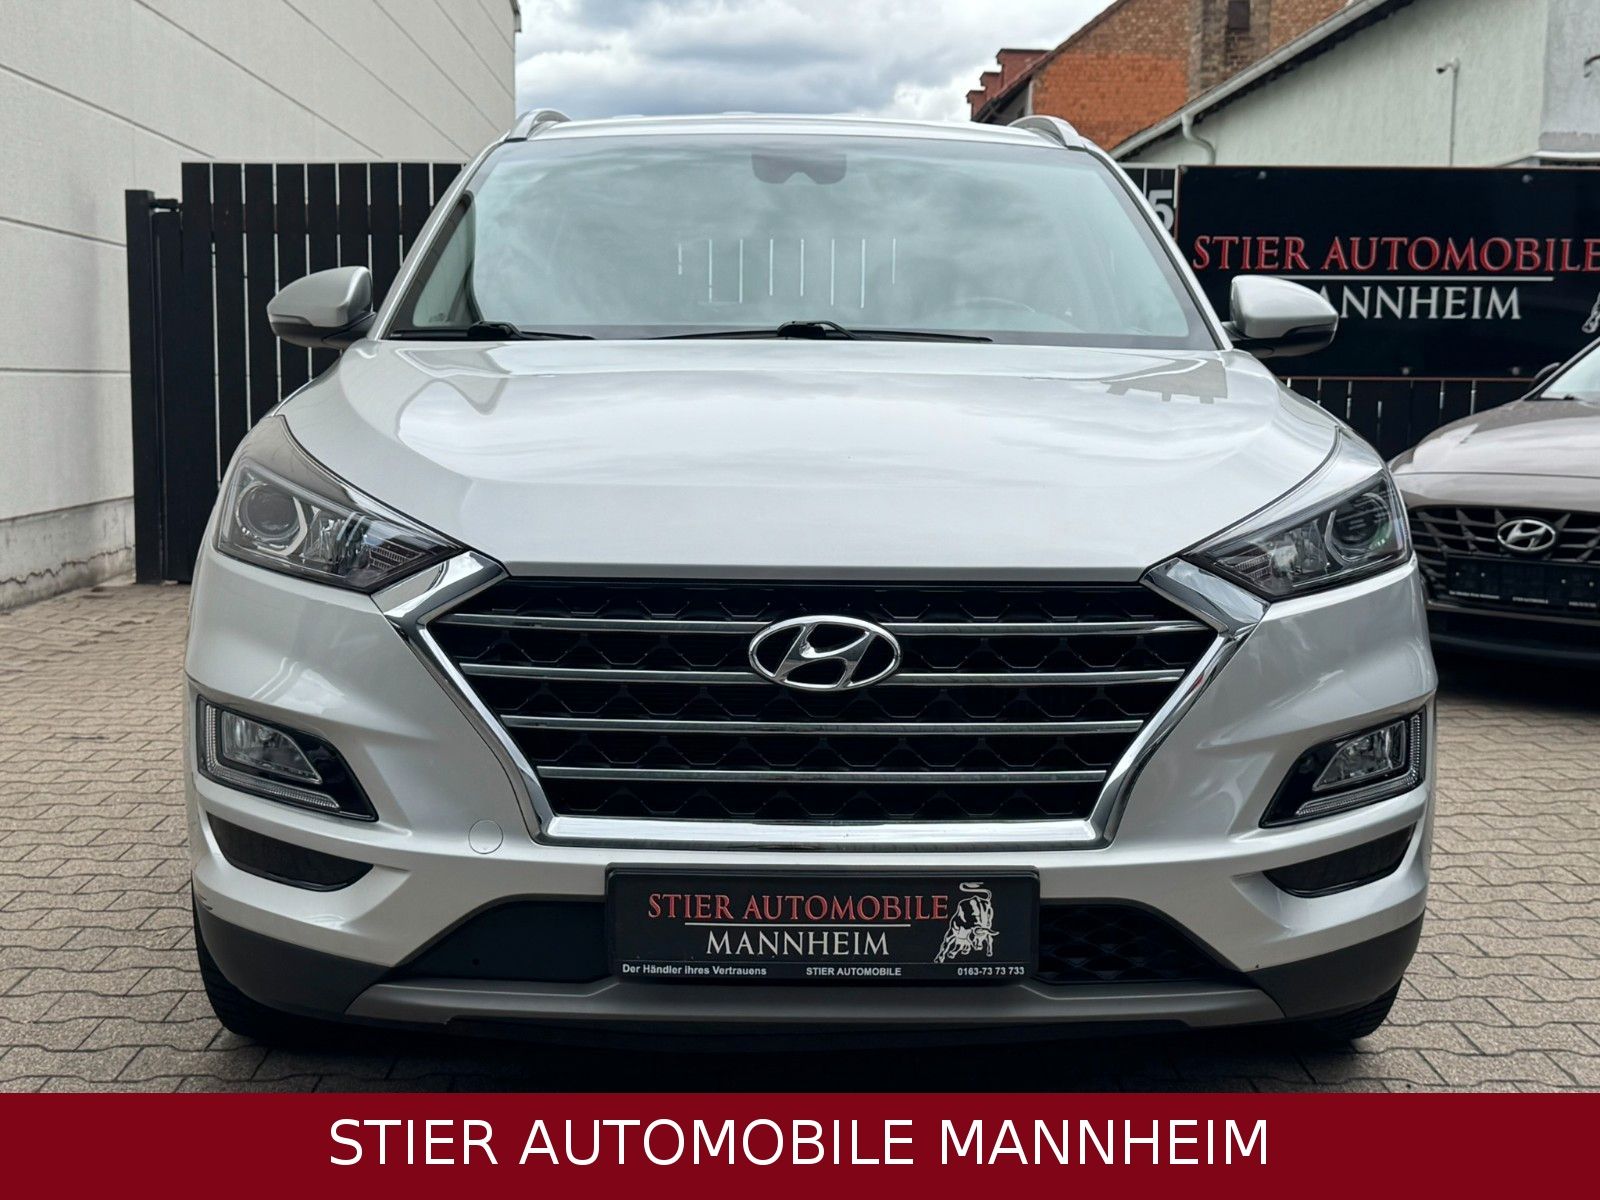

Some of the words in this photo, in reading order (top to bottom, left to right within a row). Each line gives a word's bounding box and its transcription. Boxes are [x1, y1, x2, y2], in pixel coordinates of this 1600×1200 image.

[1192, 235, 1310, 271] STIER
[1320, 236, 1600, 272] AUTOMOBILE
[1319, 285, 1521, 320] NNHEIM
[648, 893, 734, 920] STIER
[742, 894, 949, 921] AUTOMOBILE
[706, 930, 889, 956] MANNHEIM
[622, 963, 641, 974] Der
[642, 964, 683, 975] Händler
[712, 965, 767, 976] Vertrauens
[806, 966, 835, 977] STIER
[836, 967, 902, 977] AUTOMOBILE
[957, 966, 993, 977] 0163-73
[994, 966, 1006, 976] 73
[1008, 966, 1025, 976] 733
